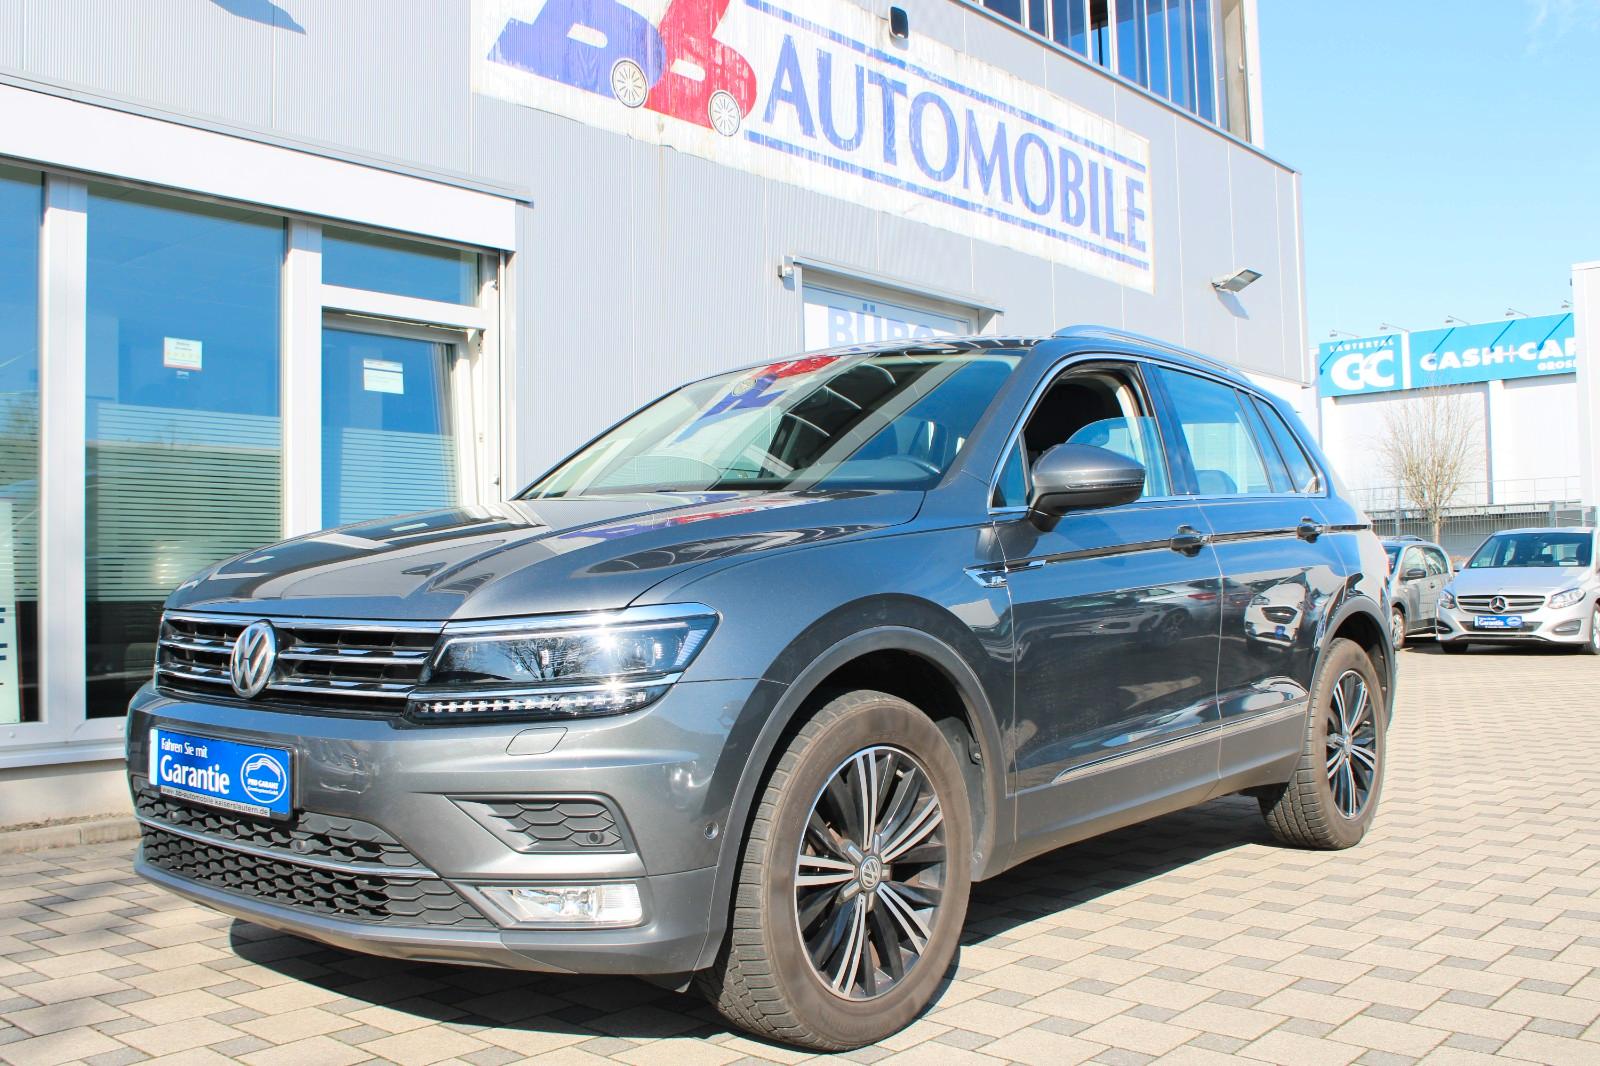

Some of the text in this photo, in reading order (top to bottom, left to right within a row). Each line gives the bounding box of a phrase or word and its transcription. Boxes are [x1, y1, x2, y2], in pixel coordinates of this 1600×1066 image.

[763, 34, 1147, 253] AUTOMOBILE
[1329, 338, 1394, 353] LAUTERTAL
[1537, 360, 1576, 371] GROS
[161, 738, 208, 759] Fahren Sie mit
[160, 754, 230, 795] Garantie
